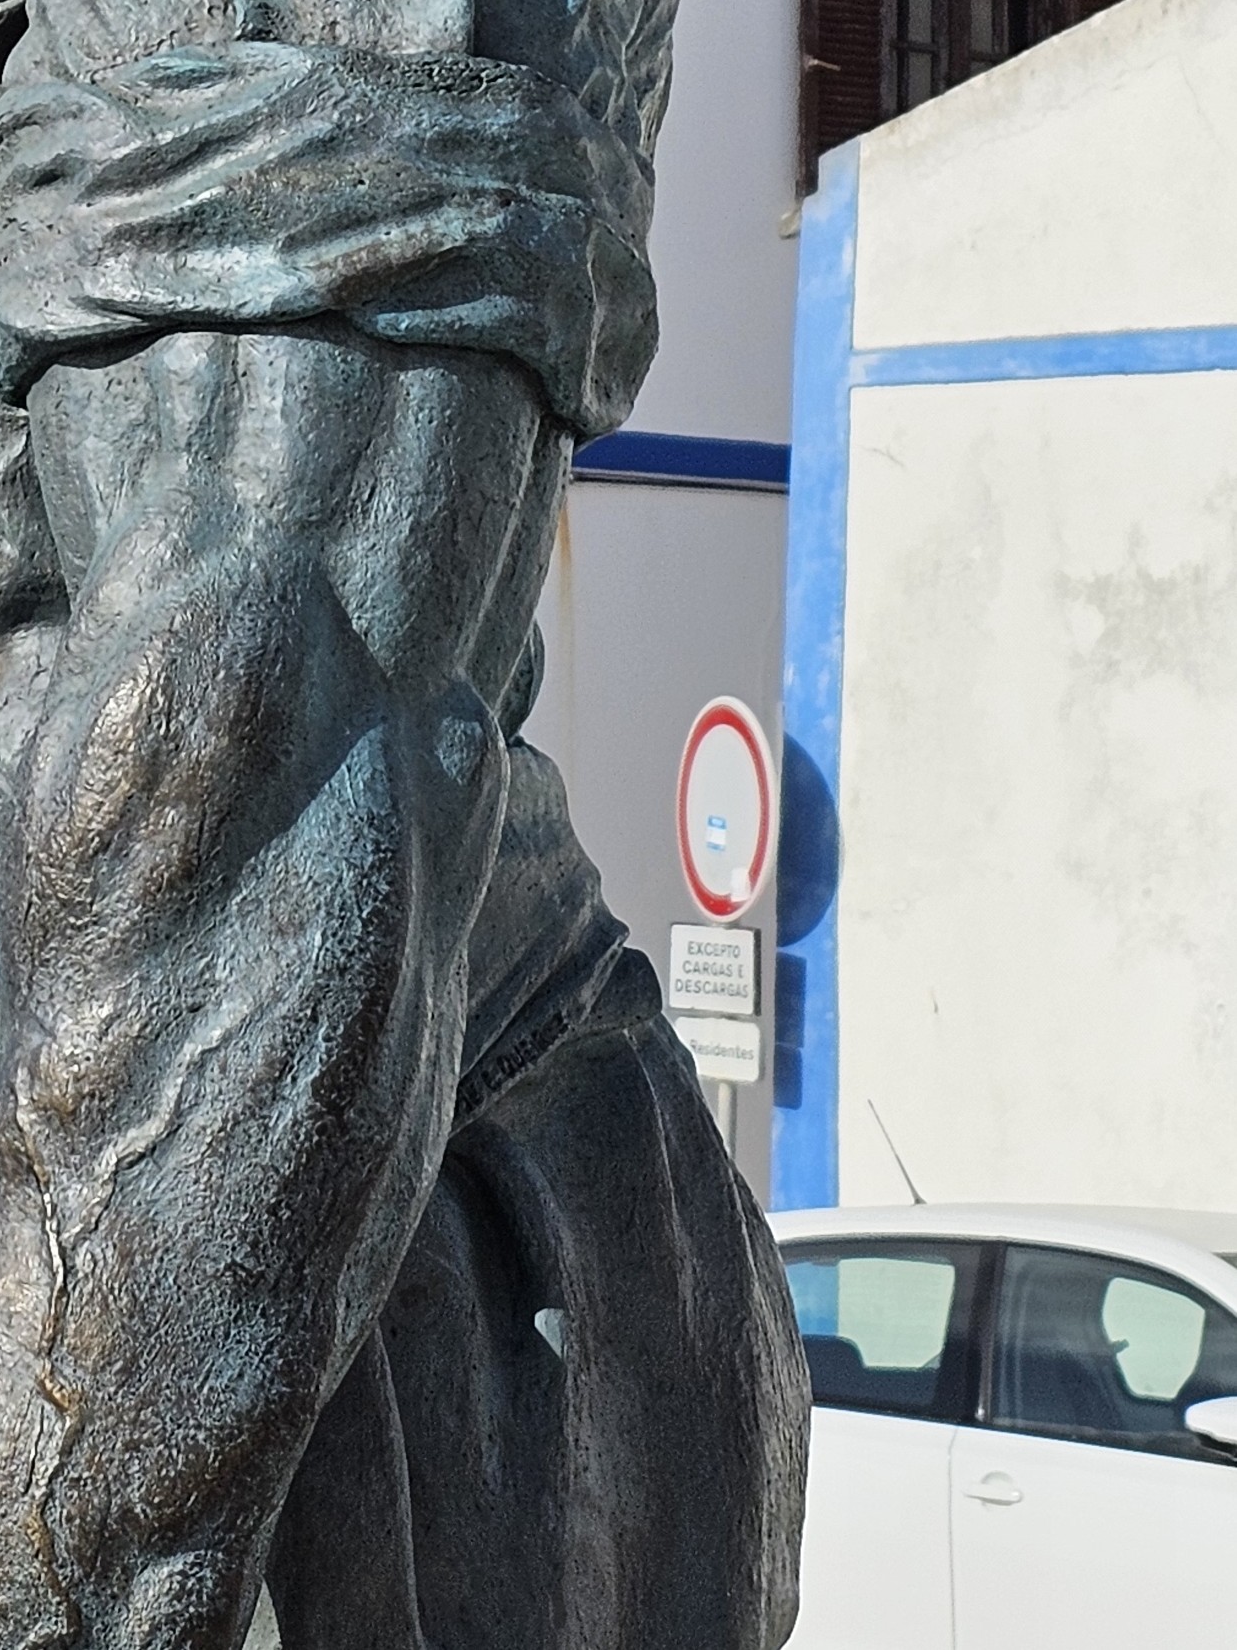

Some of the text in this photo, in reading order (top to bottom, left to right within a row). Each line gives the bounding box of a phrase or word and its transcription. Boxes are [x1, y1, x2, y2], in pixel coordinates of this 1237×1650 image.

[687, 940, 741, 958] EXCEPTO
[682, 960, 744, 978] CARGAS E
[675, 978, 749, 998] DESCARGAS
[690, 1039, 754, 1061] Residentes
